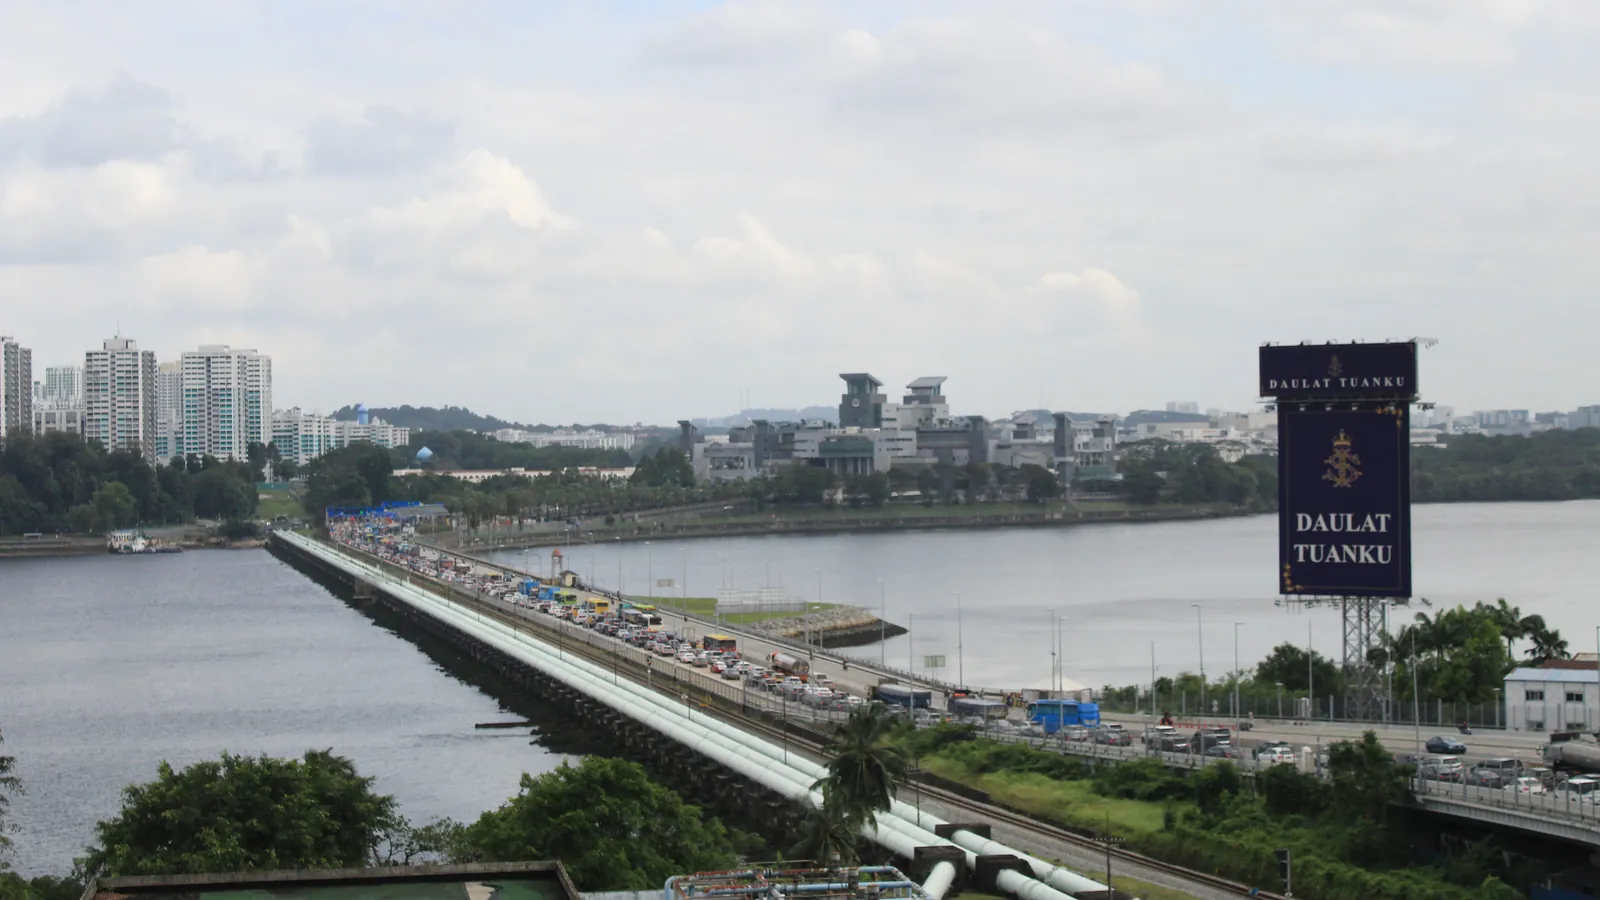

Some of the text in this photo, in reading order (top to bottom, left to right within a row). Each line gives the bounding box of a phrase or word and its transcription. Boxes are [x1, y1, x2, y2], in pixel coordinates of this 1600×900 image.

[1269, 377, 1405, 389] DAULAT TUANKU
[1296, 513, 1391, 532] DAULAT
[1293, 544, 1392, 564] TUANKU
